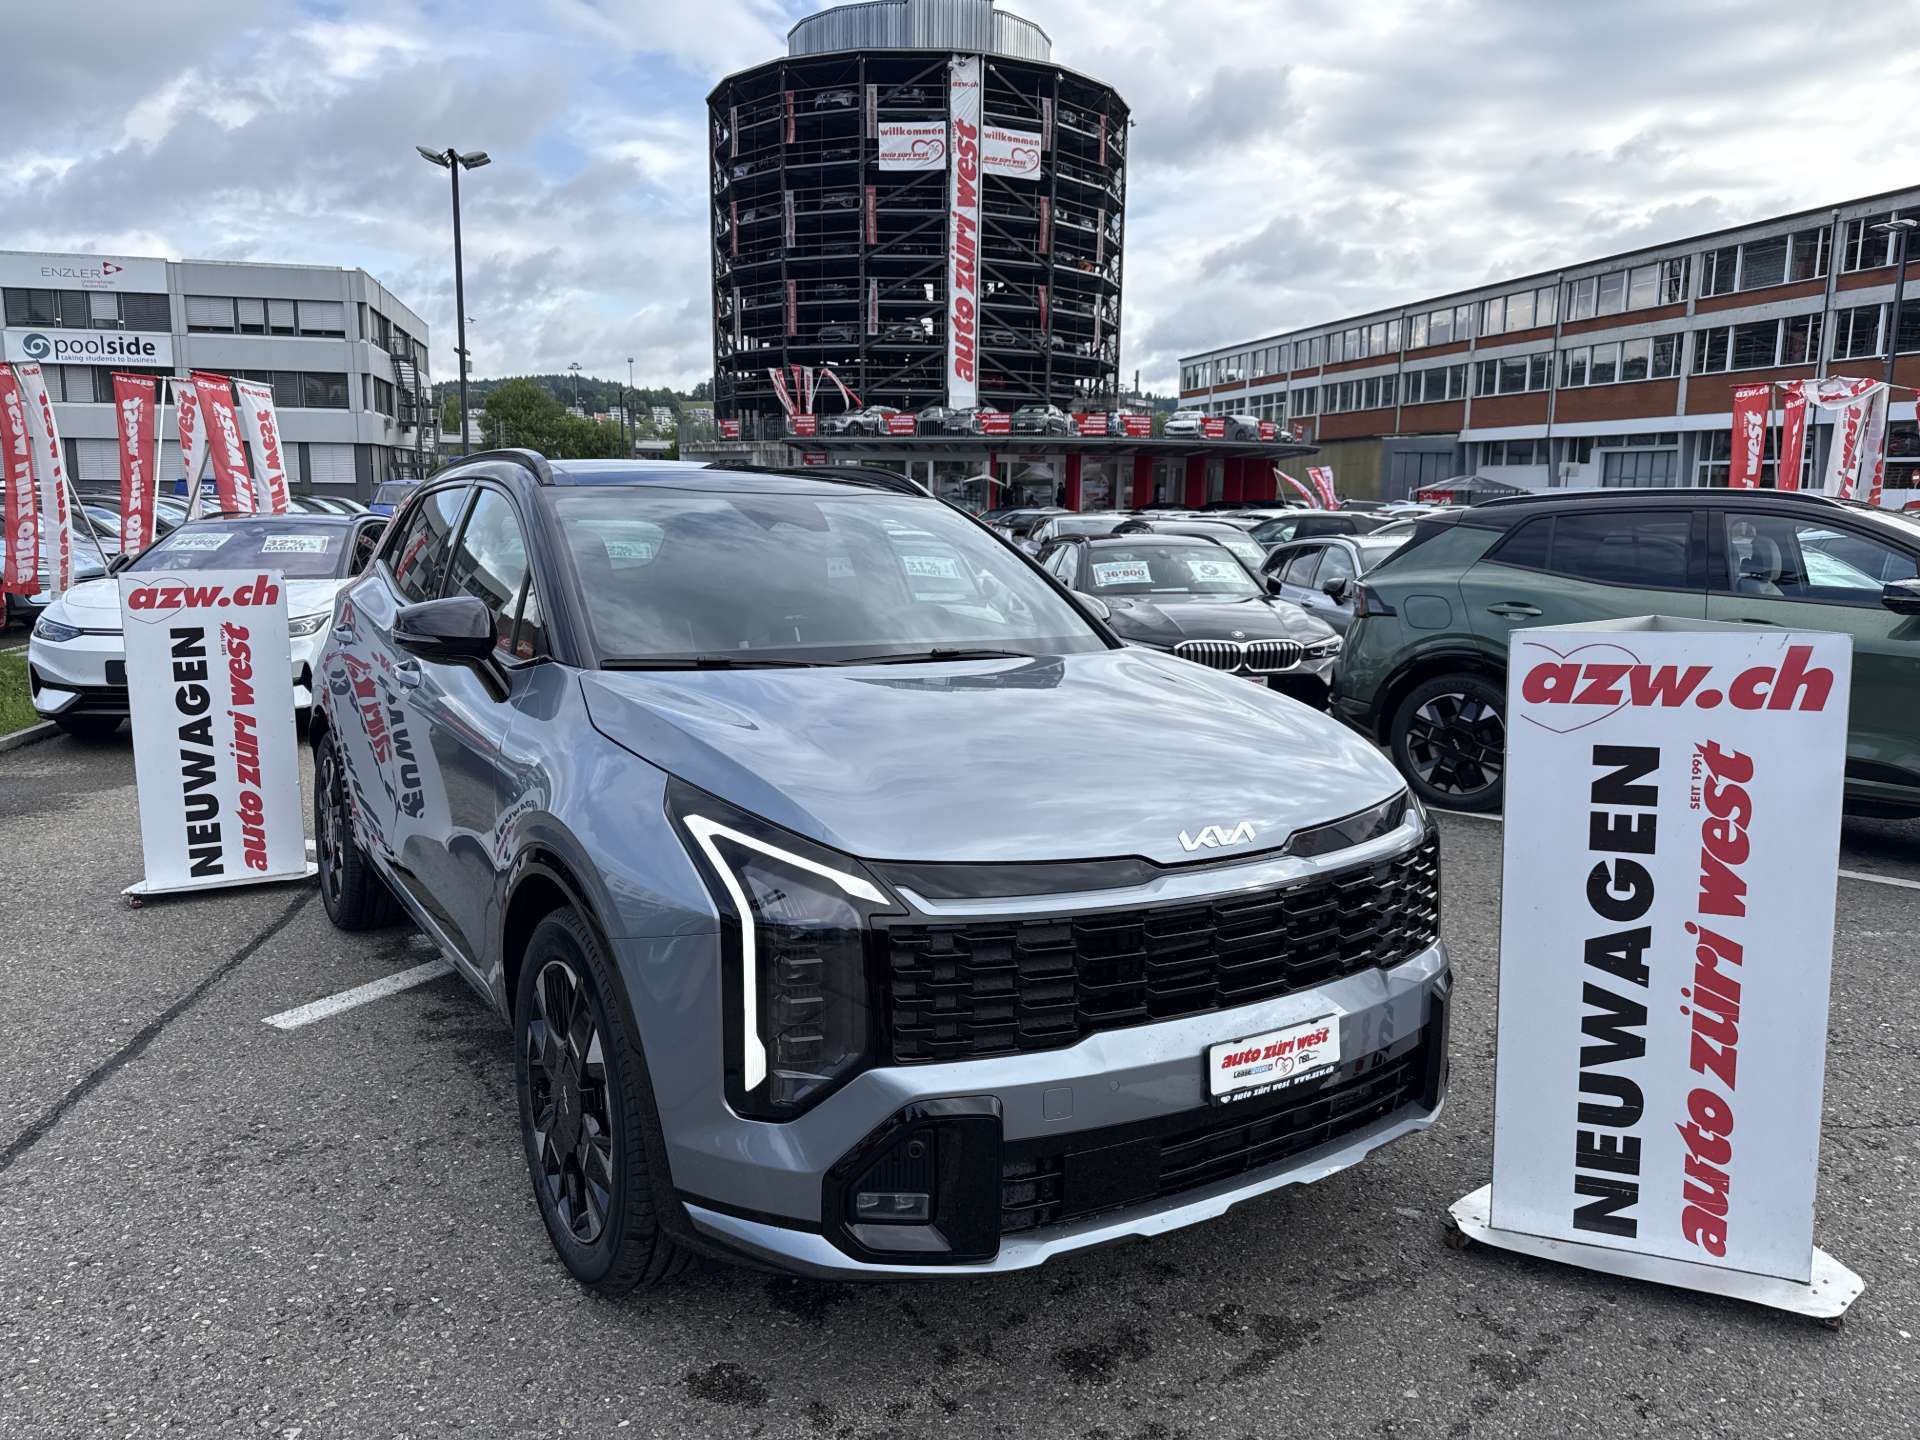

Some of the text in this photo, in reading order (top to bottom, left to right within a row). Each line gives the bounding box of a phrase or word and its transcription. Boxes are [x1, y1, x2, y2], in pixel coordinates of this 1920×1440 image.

[880, 126, 944, 136] willkommen
[984, 131, 1040, 146] willkommen
[41, 266, 100, 278] ENZLER
[951, 117, 978, 383] auto züri west
[54, 336, 156, 360] poolside
[61, 354, 84, 362] taking
[1744, 410, 1763, 476] west
[128, 575, 280, 610] azw.ch
[1522, 646, 1834, 712] azw.ch
[170, 626, 224, 878] NEUWAGEN
[221, 622, 268, 872] auto züri west
[1690, 752, 1704, 810] SEIT 1991
[1572, 744, 1660, 1240] NEUWAGEN
[1674, 738, 1755, 1258] auto züri west
[1222, 1047, 1261, 1069] auto
[1262, 1036, 1295, 1060] züri
[1297, 1027, 1330, 1050] west
[1232, 1090, 1252, 1102] auto
[1272, 1080, 1290, 1090] west
